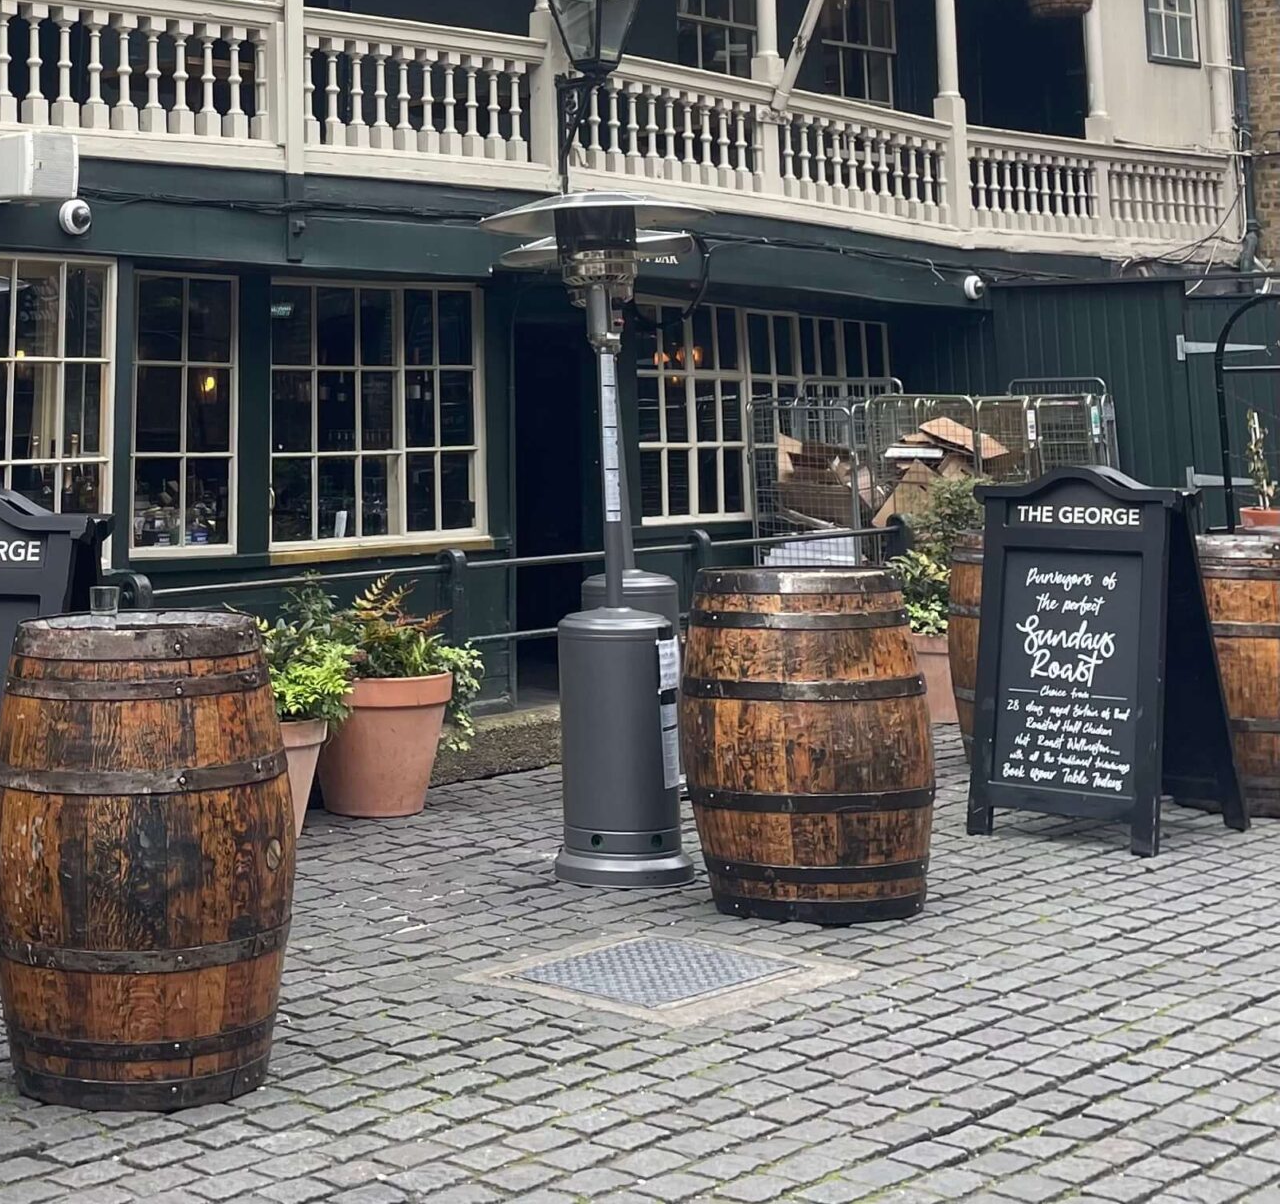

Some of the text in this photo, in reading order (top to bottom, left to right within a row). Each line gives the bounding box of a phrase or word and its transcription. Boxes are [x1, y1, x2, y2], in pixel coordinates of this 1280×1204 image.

[1017, 505, 1140, 525] THE GEORGE
[1026, 567, 1118, 592] Purveyors of
[1061, 595, 1105, 616] perfect
[1030, 649, 1103, 687] Roast
[1040, 685, 1090, 699] Choice from
[1007, 699, 1020, 711] 28
[1100, 707, 1111, 720] of
[1037, 733, 1065, 750] Roast
[1002, 762, 1026, 778] Book
[1061, 767, 1090, 784] Table
[1091, 771, 1124, 792] Today
